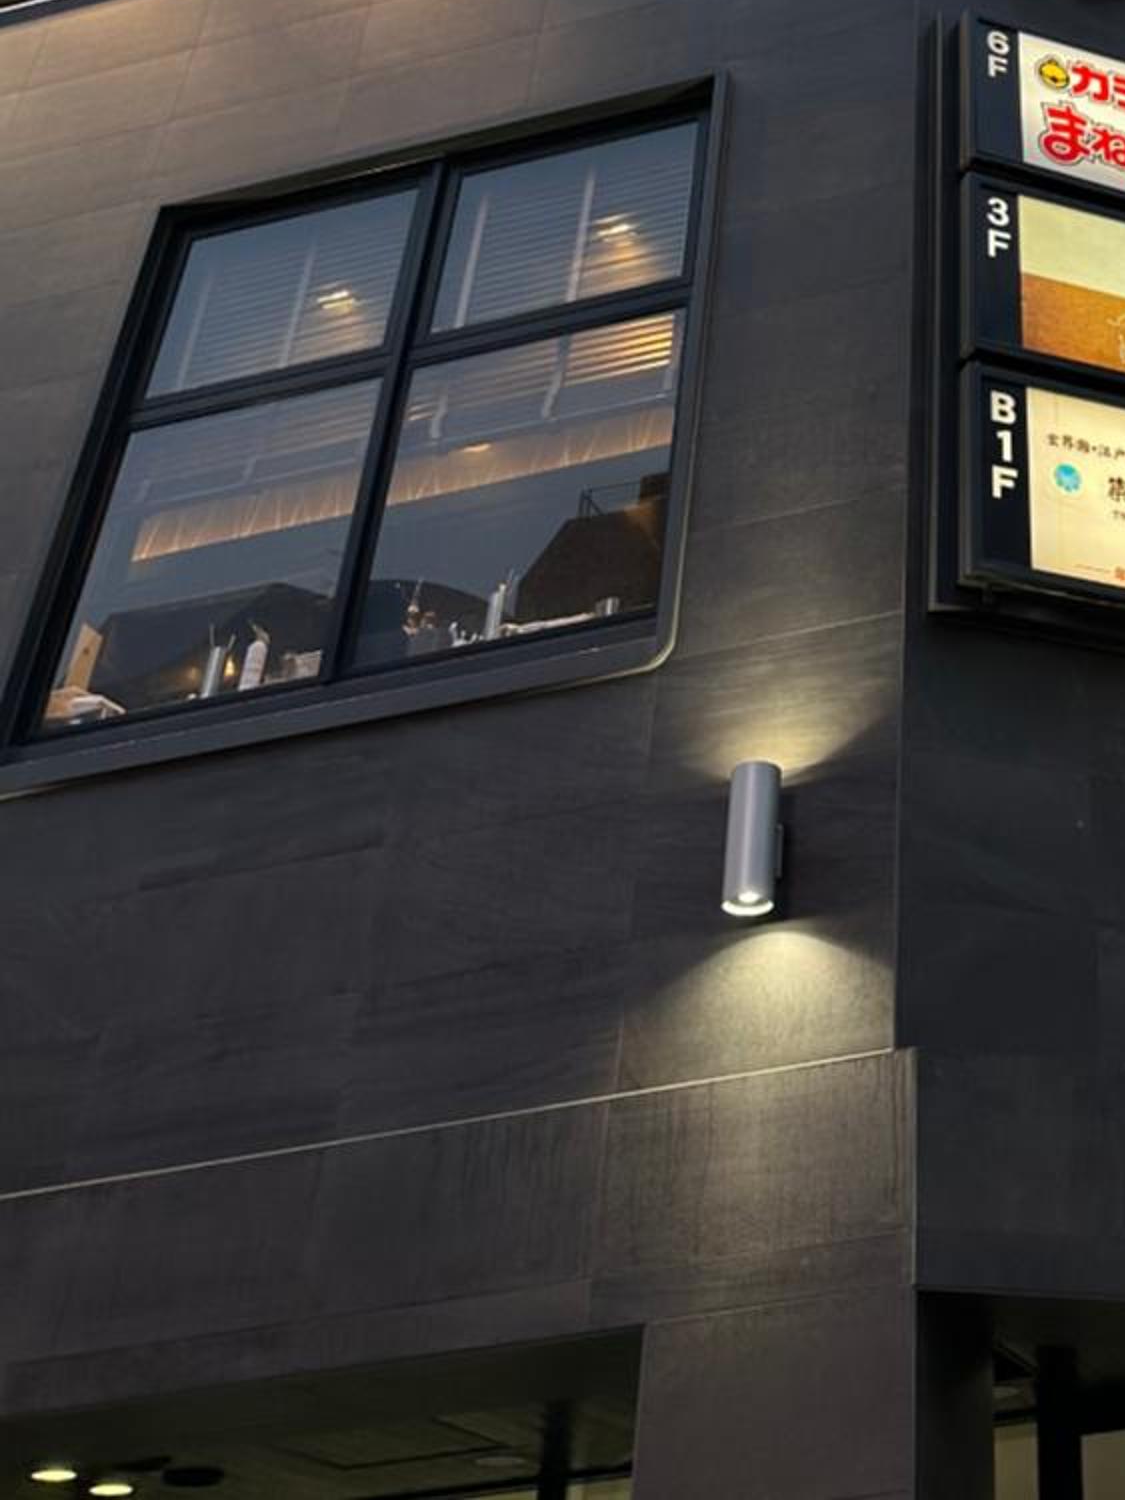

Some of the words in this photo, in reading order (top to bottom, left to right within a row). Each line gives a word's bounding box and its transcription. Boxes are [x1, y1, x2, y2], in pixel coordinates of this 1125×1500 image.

[986, 30, 1011, 78] 6F
[986, 198, 1012, 258] 3F
[990, 390, 1019, 499] B1F
